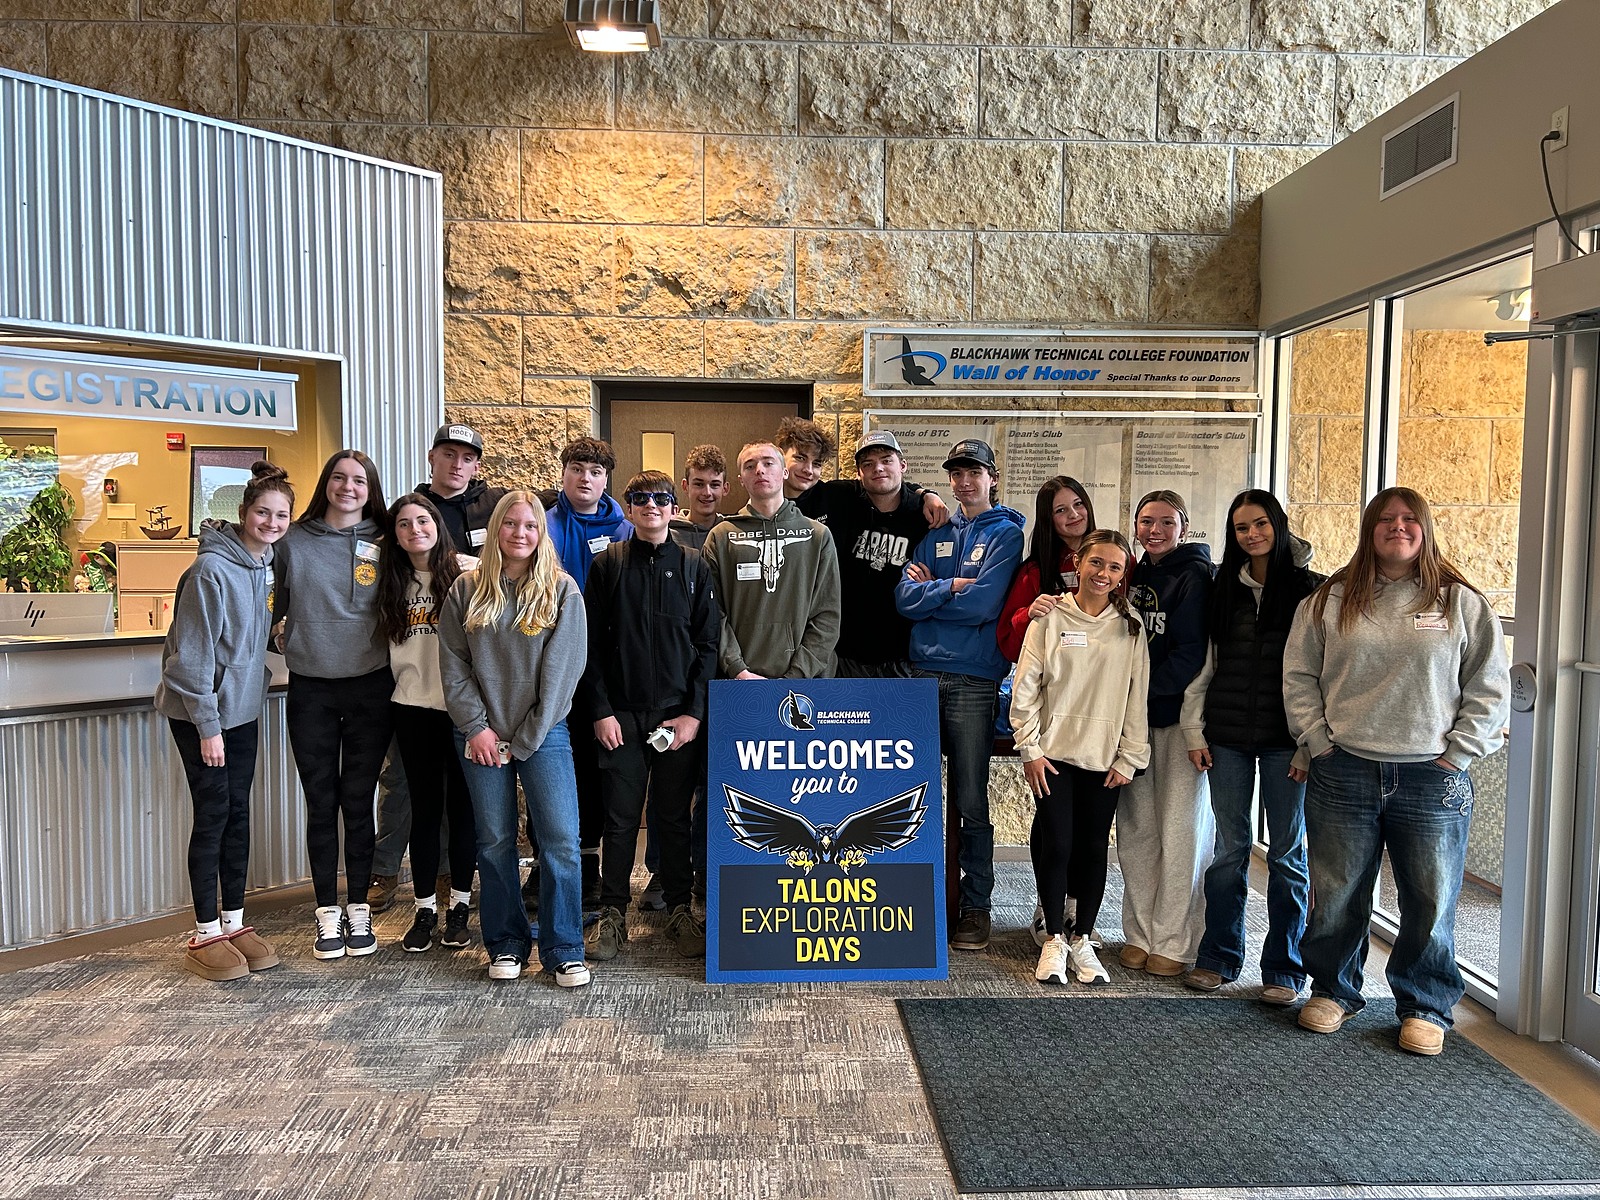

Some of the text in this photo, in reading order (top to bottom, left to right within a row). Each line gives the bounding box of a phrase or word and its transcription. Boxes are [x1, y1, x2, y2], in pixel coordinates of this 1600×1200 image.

[950, 348, 1250, 363] BLACKHAWK TECHNICAL COLLEGE FOUNDATION
[953, 365, 1100, 381] Wall of Honor
[1107, 373, 1142, 383] Special
[1144, 374, 1177, 382] Thanks
[1179, 374, 1189, 382] to
[1209, 374, 1240, 383] Donors
[0, 366, 276, 417] EGISTRATION
[1008, 430, 1063, 438] Dean's Club
[777, 528, 814, 536] DAIRY
[736, 739, 915, 770] WELCOMES
[790, 771, 858, 804] you to
[778, 878, 877, 903] TALONS
[742, 906, 913, 933] EXPLORATION
[796, 937, 861, 962] DAYS
